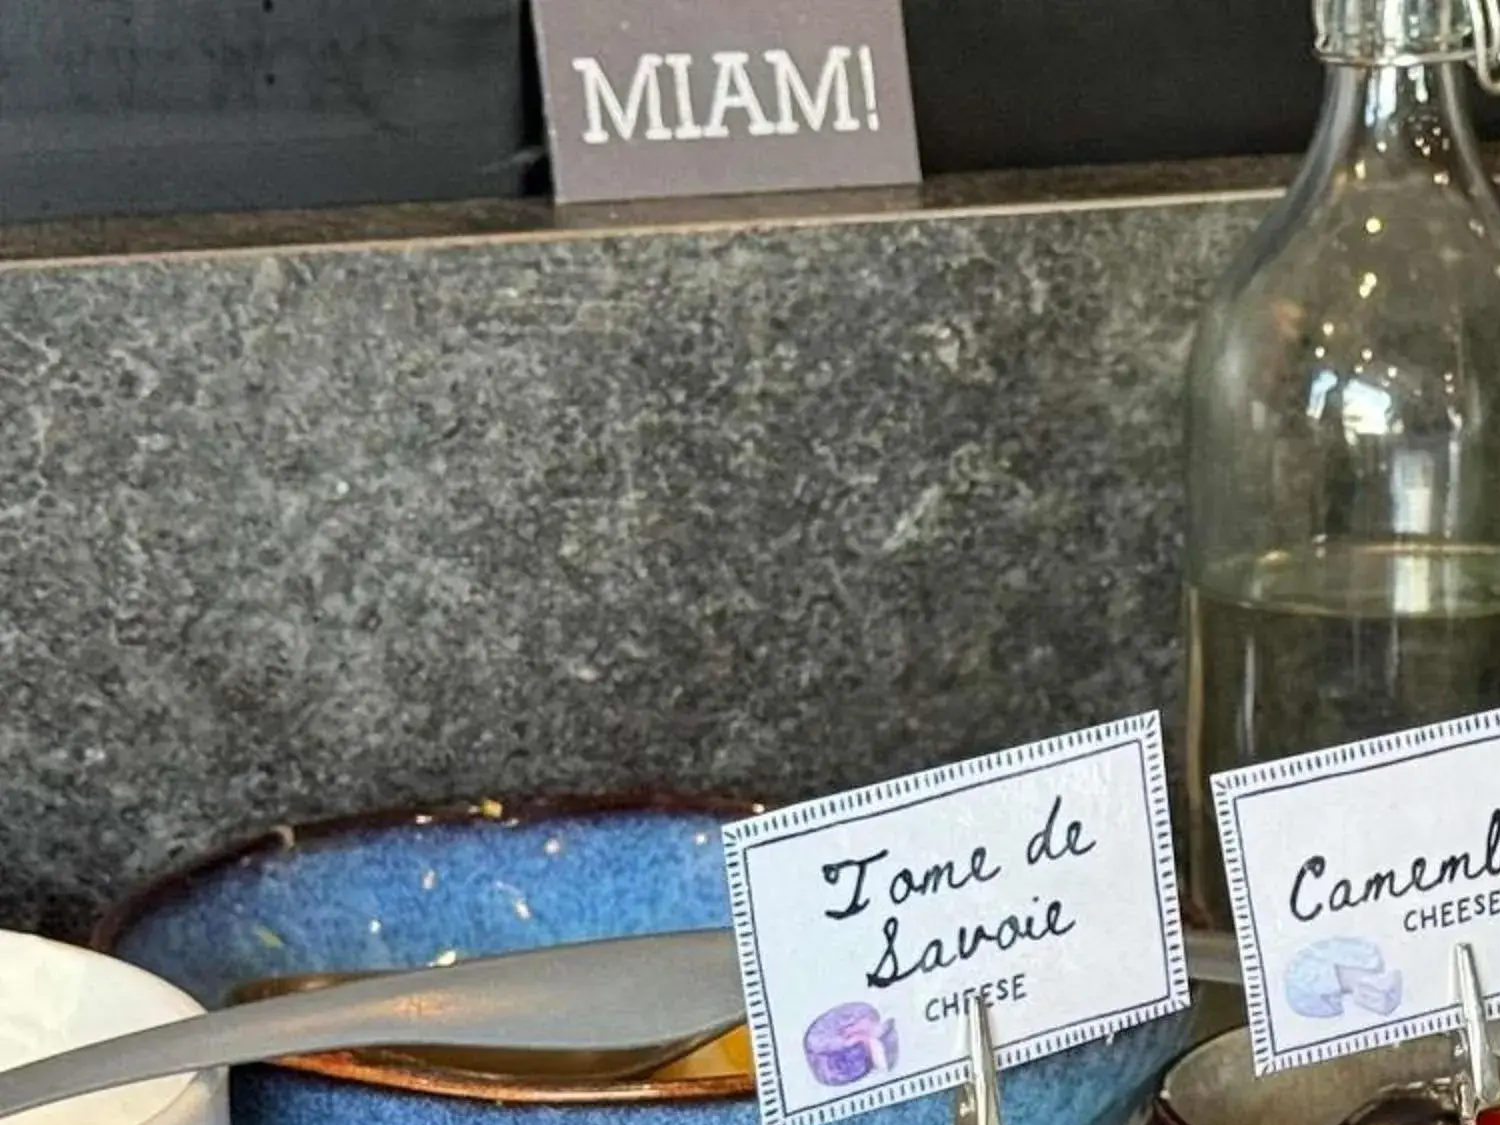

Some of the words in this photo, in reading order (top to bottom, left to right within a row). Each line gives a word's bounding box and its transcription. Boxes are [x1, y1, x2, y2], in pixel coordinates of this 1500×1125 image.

[572, 45, 879, 144] MIAM!
[821, 846, 1001, 919] Tome
[1027, 794, 1096, 866] de
[866, 896, 1076, 988] Savoie
